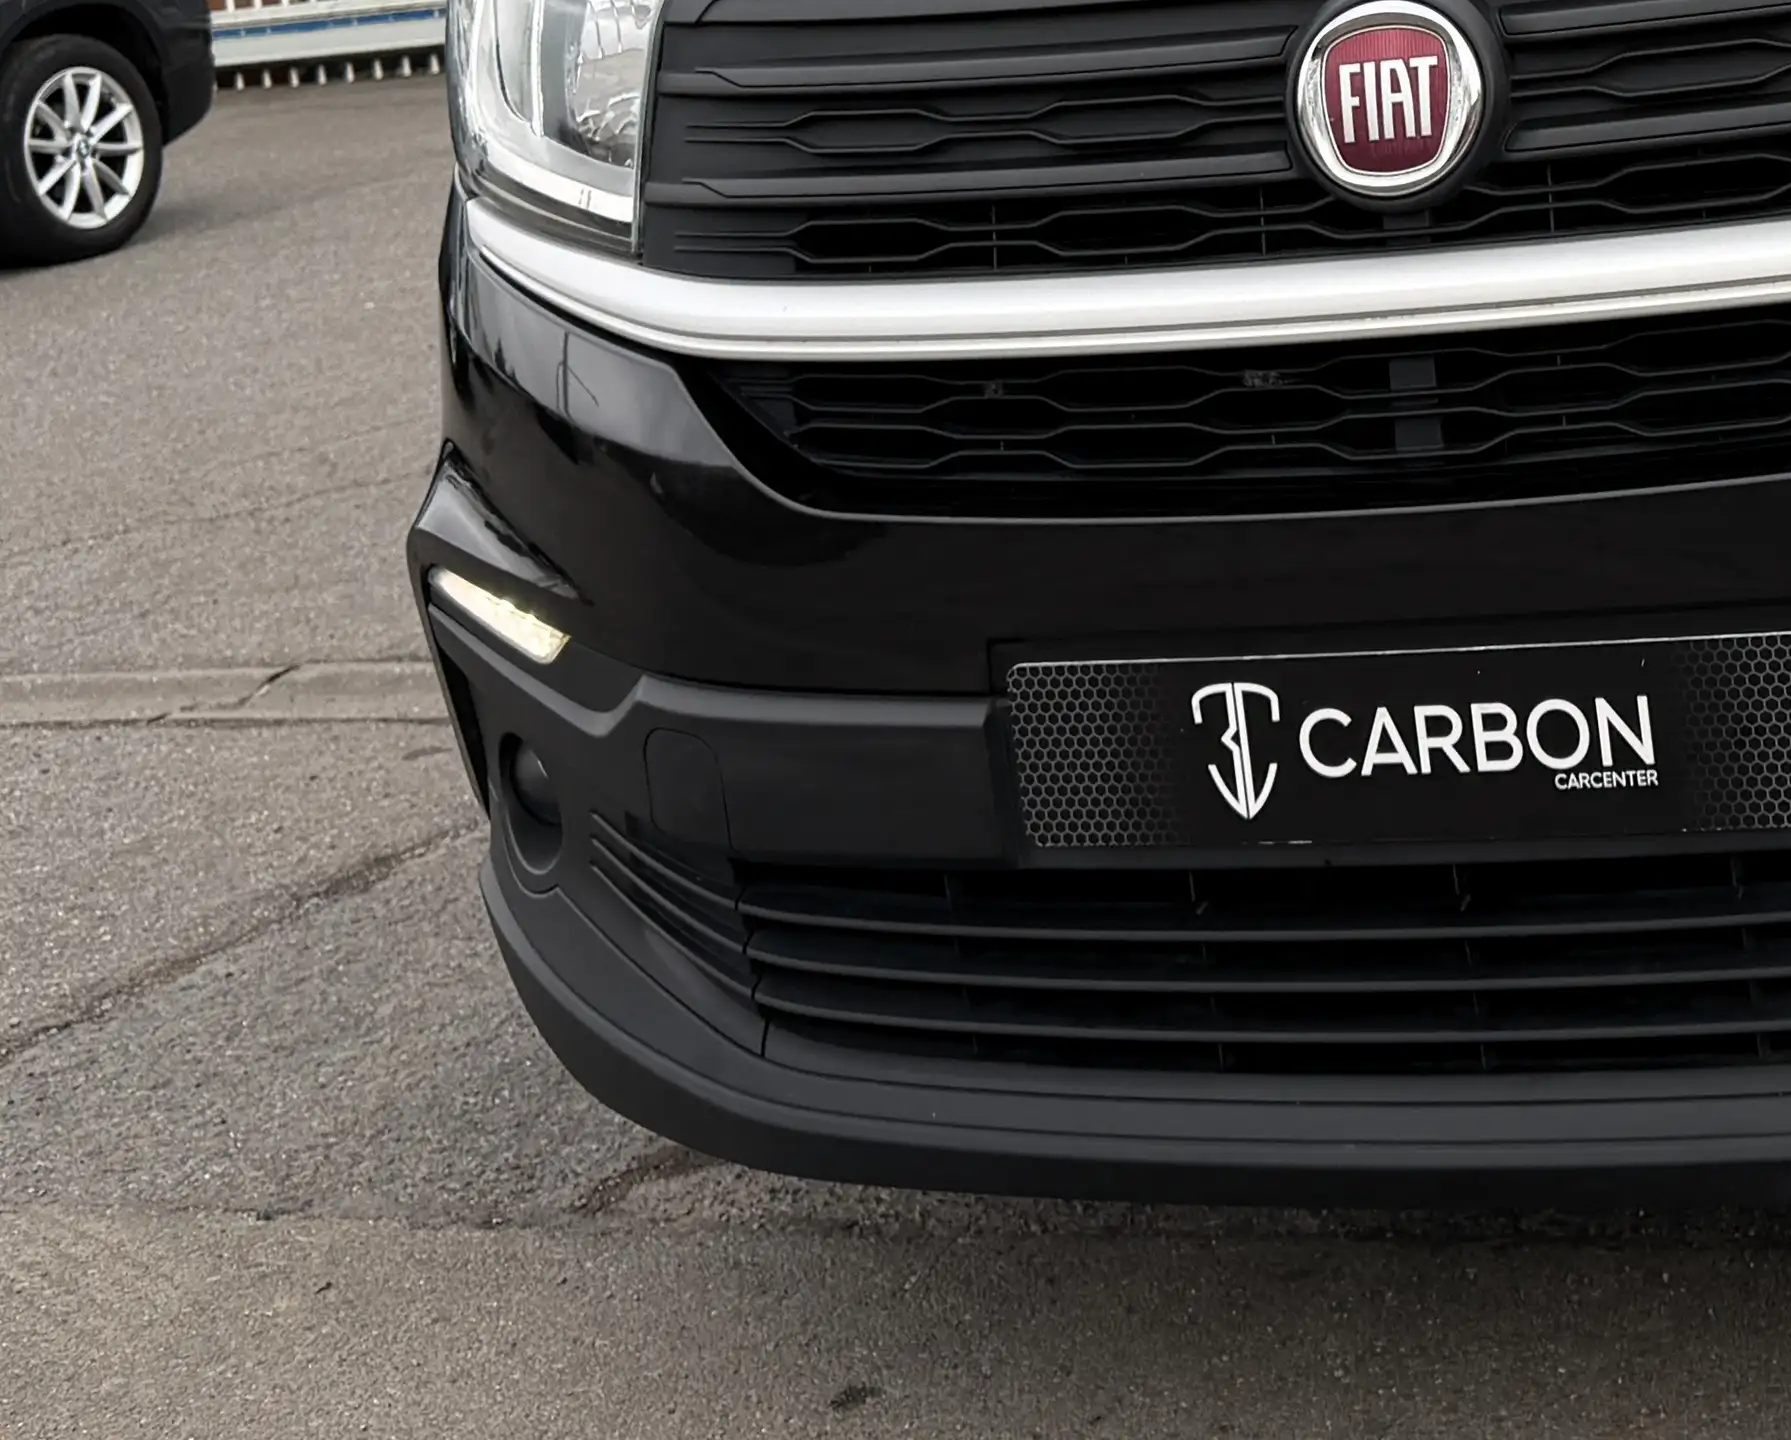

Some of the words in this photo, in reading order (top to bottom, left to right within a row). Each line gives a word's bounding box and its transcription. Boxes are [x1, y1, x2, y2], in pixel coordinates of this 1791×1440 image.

[1339, 55, 1438, 144] FIAT
[1299, 695, 1656, 779] CARBON
[1554, 769, 1660, 790] CARCENTER
